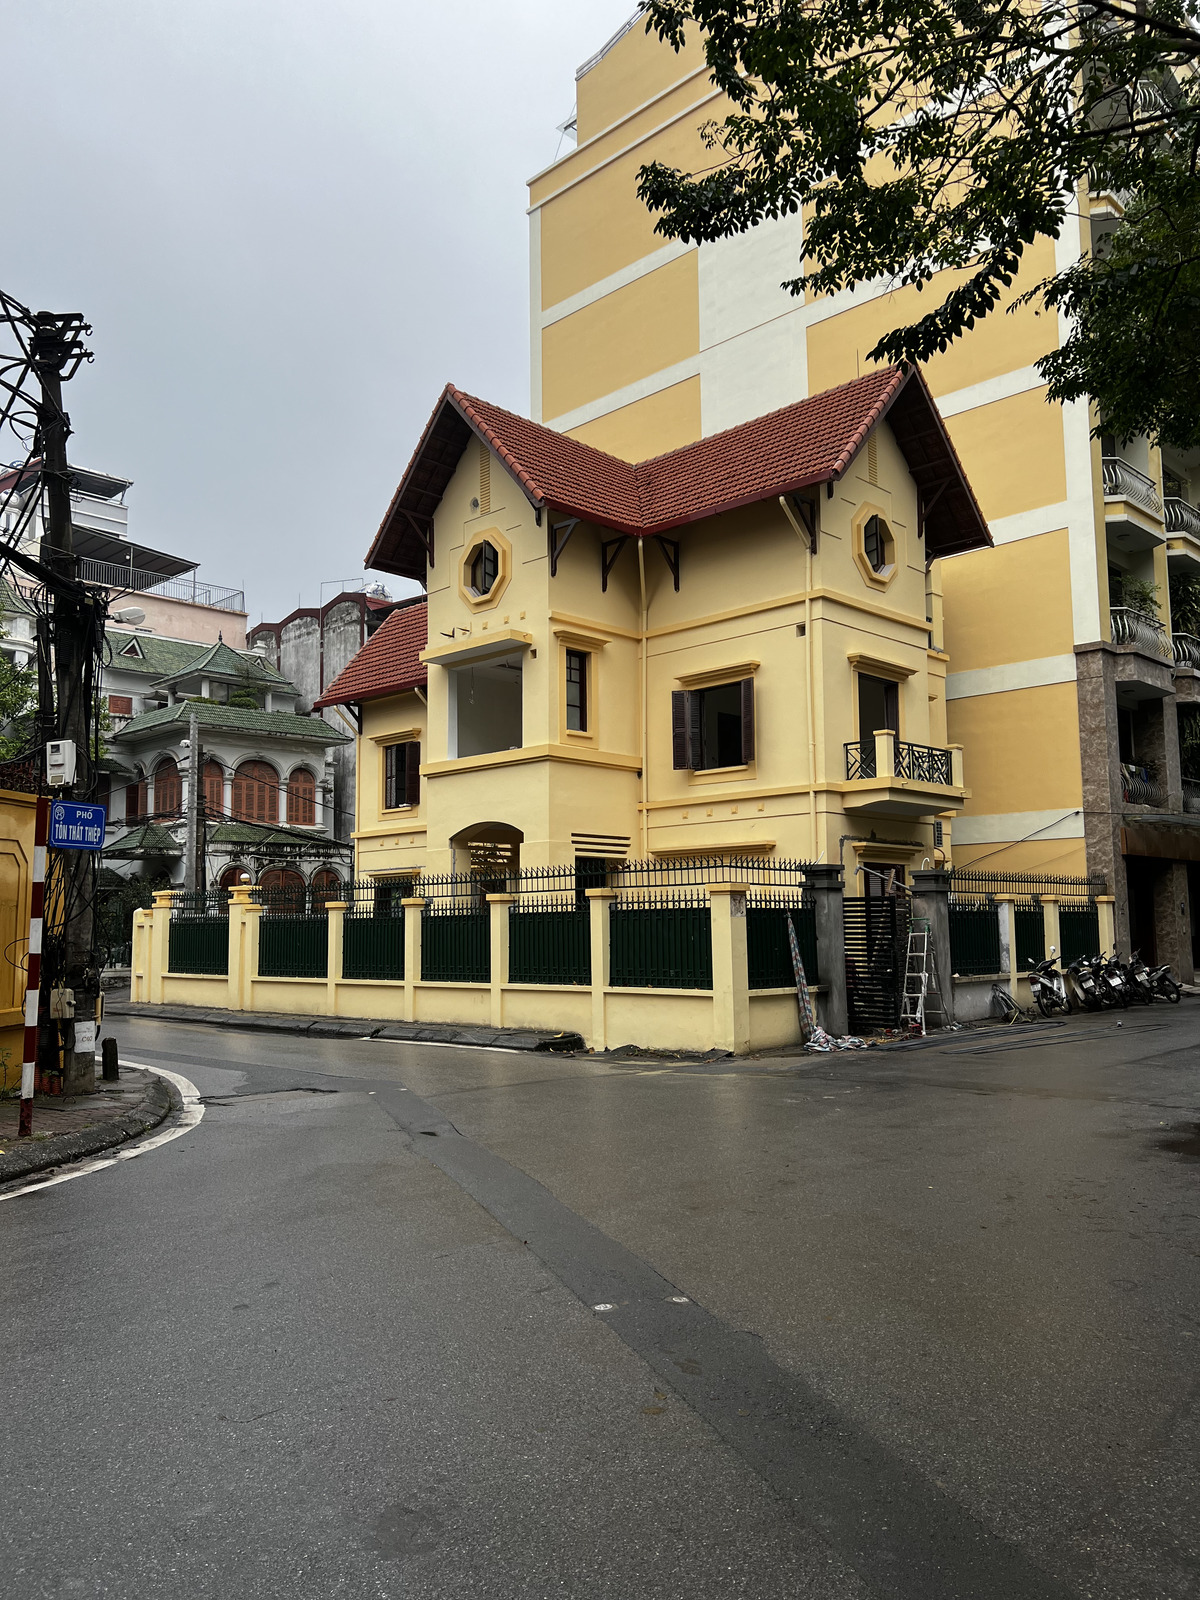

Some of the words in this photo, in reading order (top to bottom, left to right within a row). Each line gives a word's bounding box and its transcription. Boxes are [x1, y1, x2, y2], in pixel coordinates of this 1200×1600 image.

[76, 809, 93, 819] PHỐ
[55, 821, 67, 839] TÔN
[69, 821, 83, 840] THẤT
[85, 824, 101, 844] THIỆP
